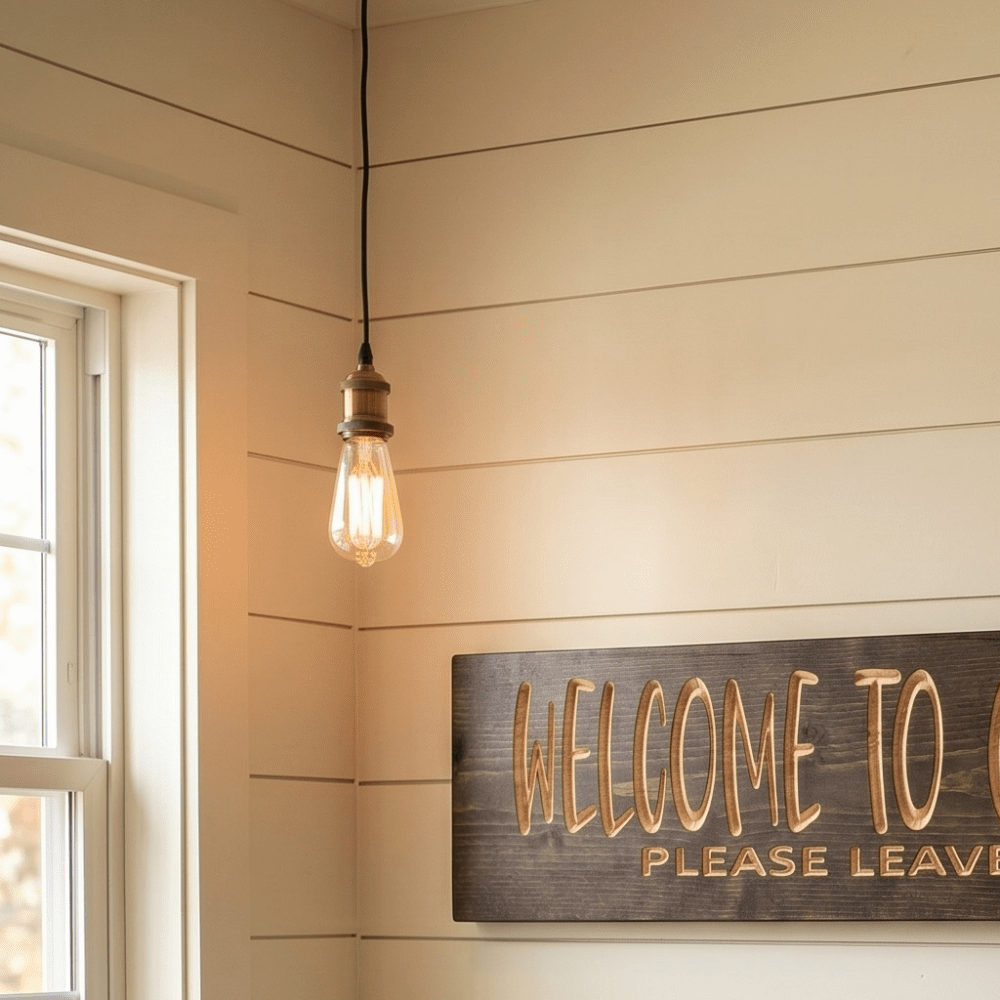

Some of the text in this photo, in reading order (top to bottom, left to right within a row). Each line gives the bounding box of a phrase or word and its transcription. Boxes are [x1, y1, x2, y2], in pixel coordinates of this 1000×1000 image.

[512, 669, 821, 838] WELCOME
[854, 668, 944, 835] TO
[640, 846, 829, 878] PLEASE
